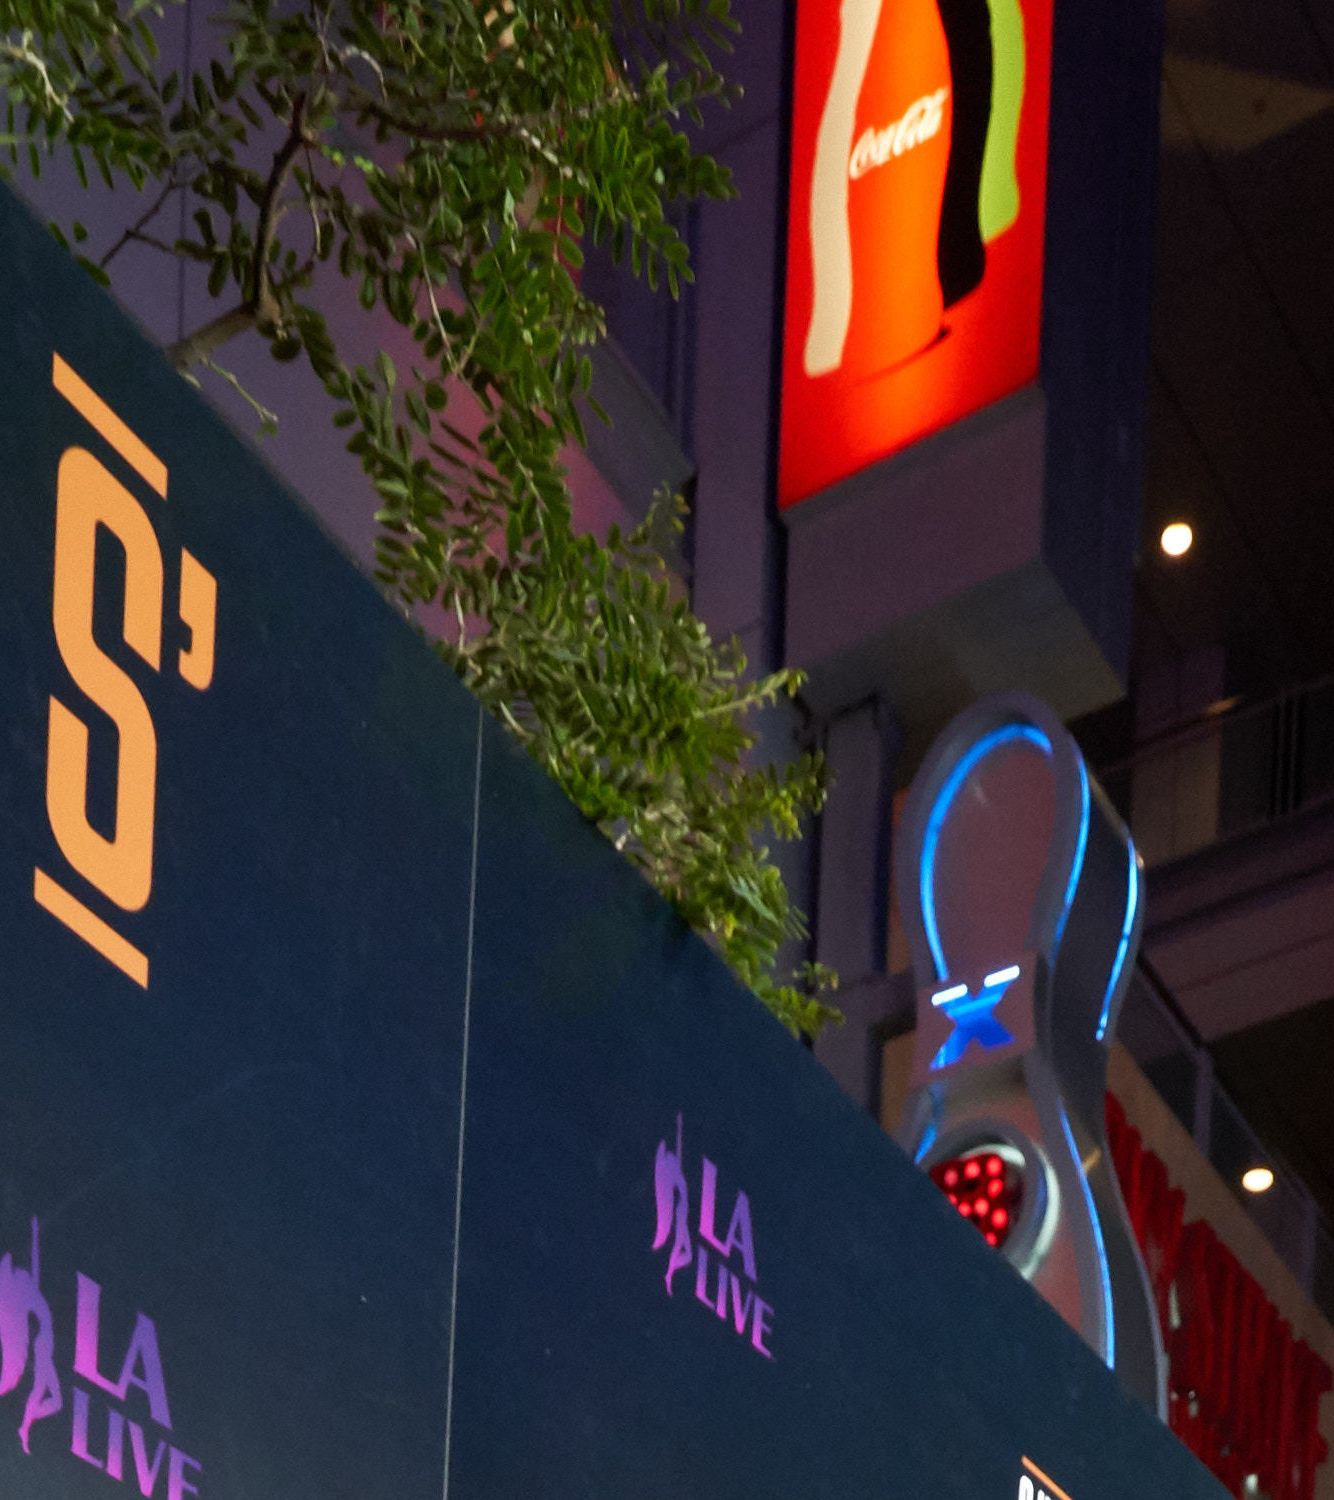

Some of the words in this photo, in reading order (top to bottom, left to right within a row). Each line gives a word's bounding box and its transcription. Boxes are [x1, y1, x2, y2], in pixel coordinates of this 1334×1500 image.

[699, 1155, 758, 1283] LA
[73, 1270, 172, 1430] LA
[694, 1244, 774, 1360] LIVE
